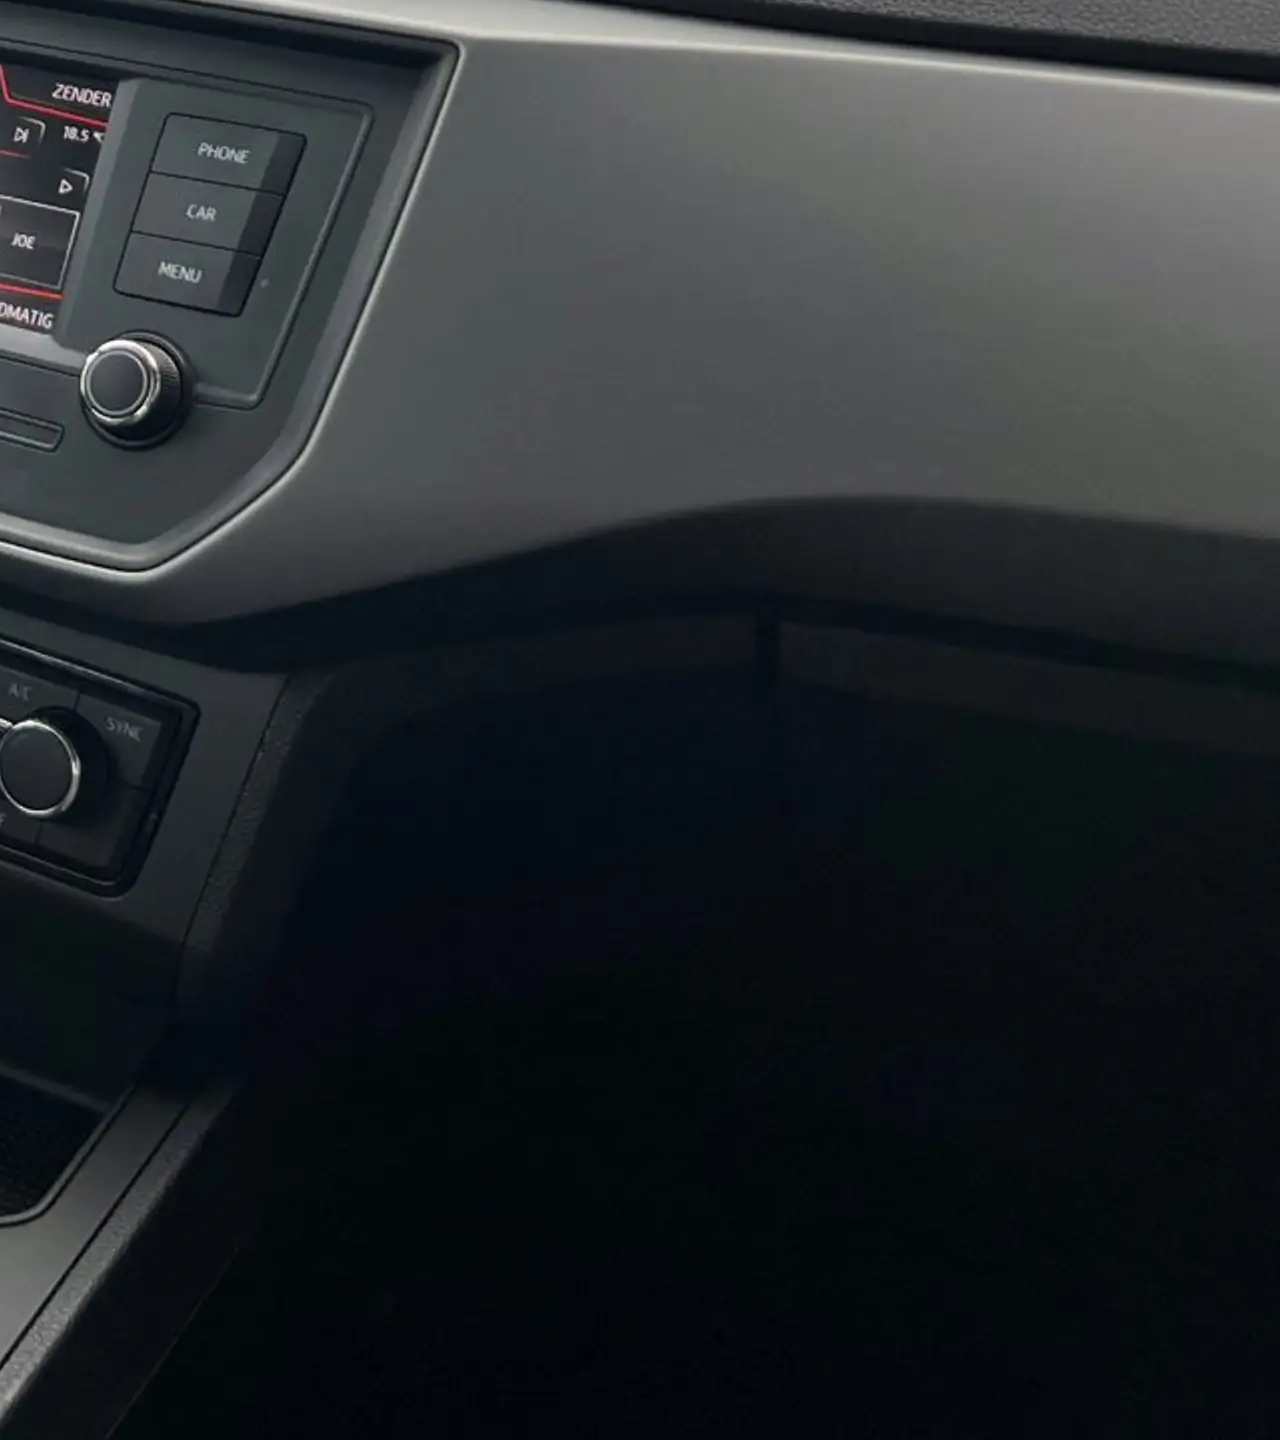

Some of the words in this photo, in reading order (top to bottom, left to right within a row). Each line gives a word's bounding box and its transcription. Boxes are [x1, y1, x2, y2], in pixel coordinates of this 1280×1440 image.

[51, 82, 113, 108] ZENDER
[197, 141, 251, 164] PHONE
[186, 203, 218, 222] CAR
[11, 232, 36, 250] JOE
[157, 261, 203, 284] MENU
[105, 716, 143, 743] SYNC
